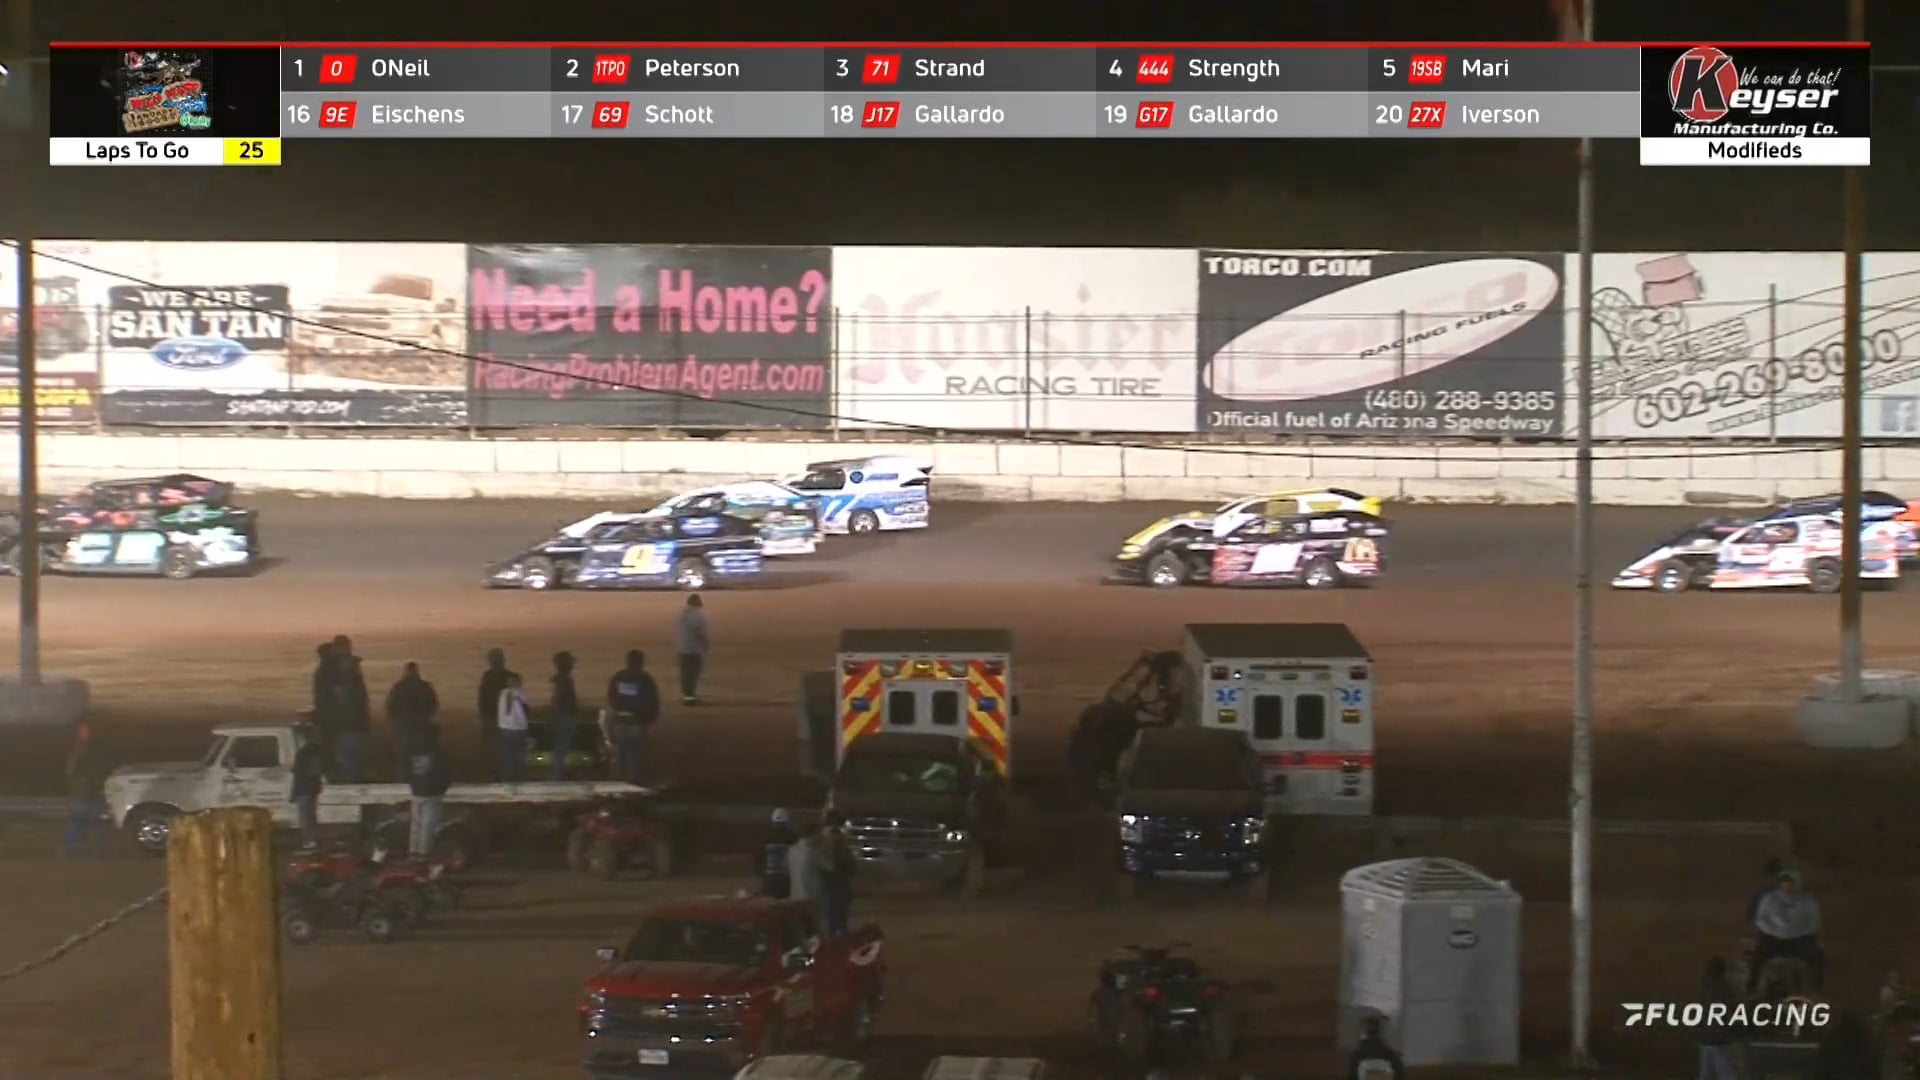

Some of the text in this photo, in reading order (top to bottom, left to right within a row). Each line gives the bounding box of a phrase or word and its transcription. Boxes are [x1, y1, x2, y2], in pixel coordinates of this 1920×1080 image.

[1204, 257, 1373, 277] TORCO.COM
[140, 291, 187, 306] WE
[471, 267, 827, 334] Need a Home?
[111, 310, 282, 338] SAN TAN
[1360, 301, 1528, 360] RACING FUELS
[474, 353, 825, 400] RacingProblemAgent.com
[945, 375, 1162, 398] RACING TIRE
[1365, 388, 1427, 412] (480)
[1285, 411, 1325, 428] fuel
[1330, 412, 1352, 428] of
[1444, 413, 1554, 433] Speedway
